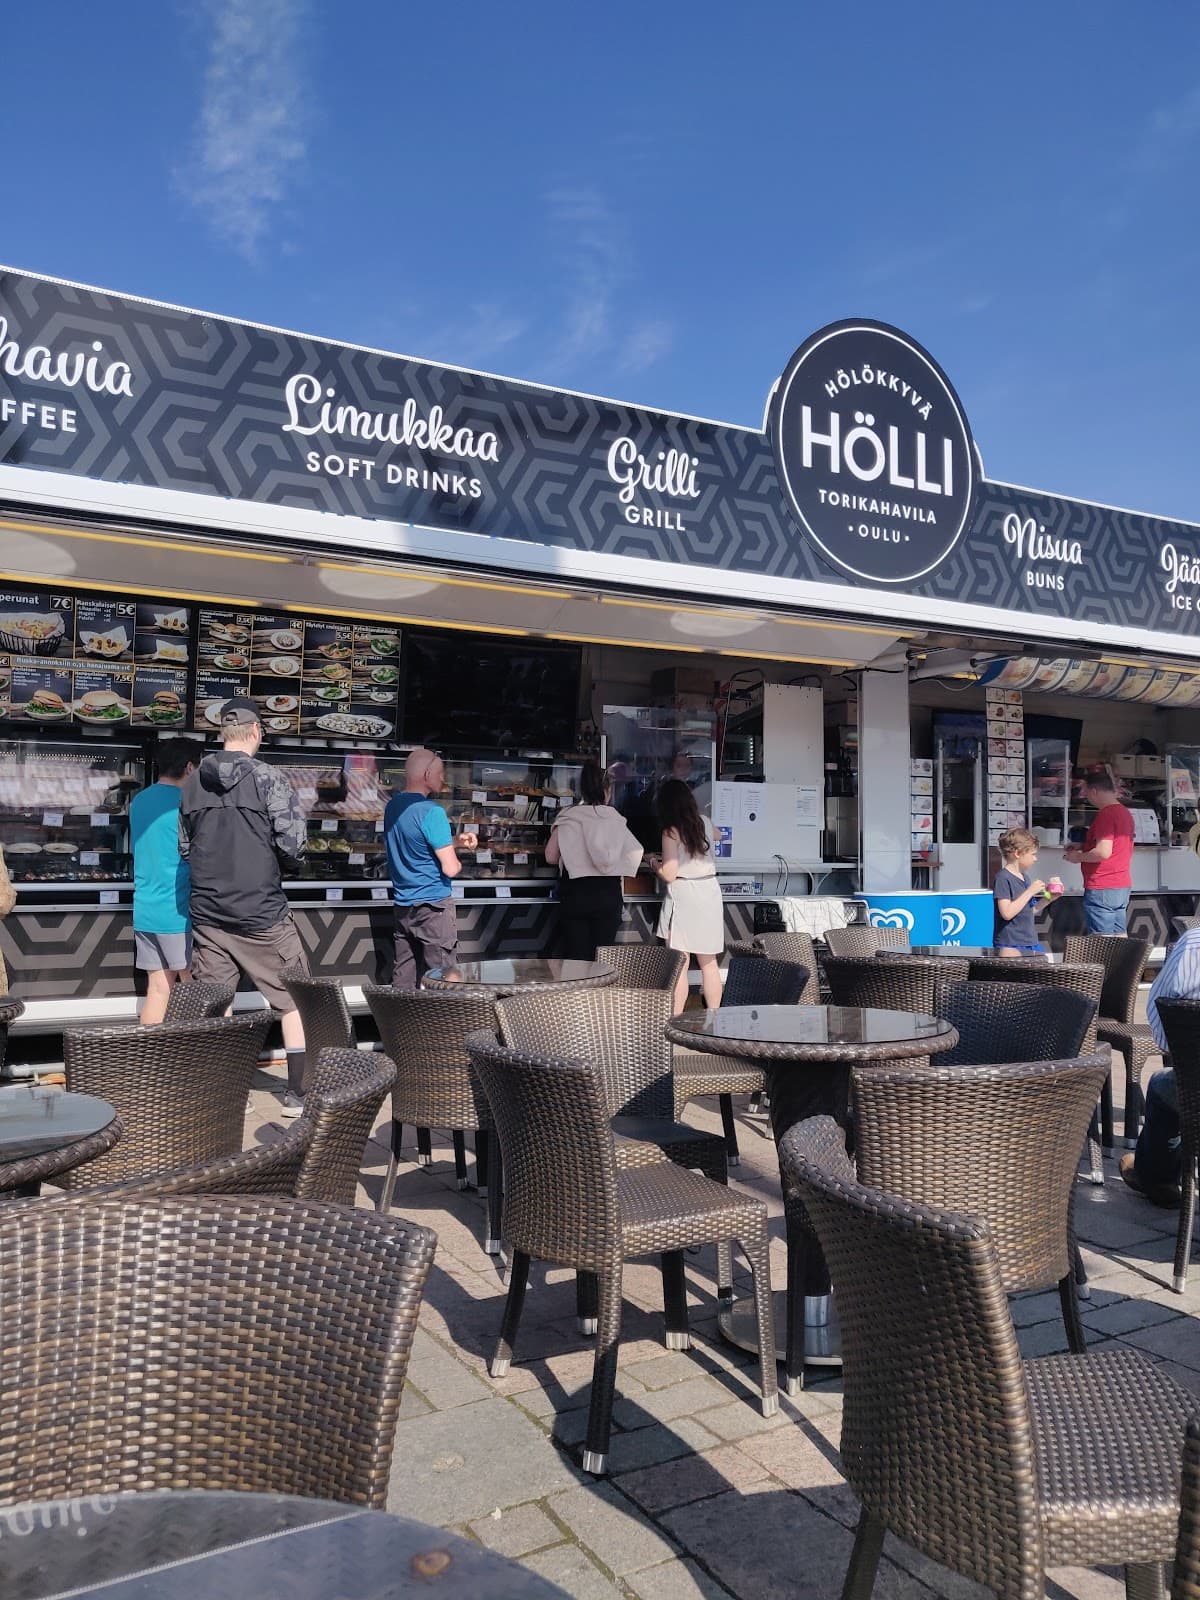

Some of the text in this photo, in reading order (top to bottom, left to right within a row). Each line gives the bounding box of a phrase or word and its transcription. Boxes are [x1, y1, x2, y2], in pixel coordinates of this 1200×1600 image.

[825, 364, 933, 421] HÖLÖKKYVÄ
[1, 398, 77, 432] FFEE
[282, 373, 499, 463] Limukkaa
[801, 405, 953, 496] HÖLLI
[306, 451, 482, 498] SOFT DRINKS
[607, 436, 700, 503] Grilli
[624, 505, 686, 531] GRILL
[819, 489, 937, 524] TORIKAHAVILA
[1003, 513, 1083, 565] Nisua
[1026, 570, 1065, 591] BUNS
[52, 597, 71, 609] 7€
[117, 604, 135, 615] 5€
[1172, 594, 1193, 611] ICE
